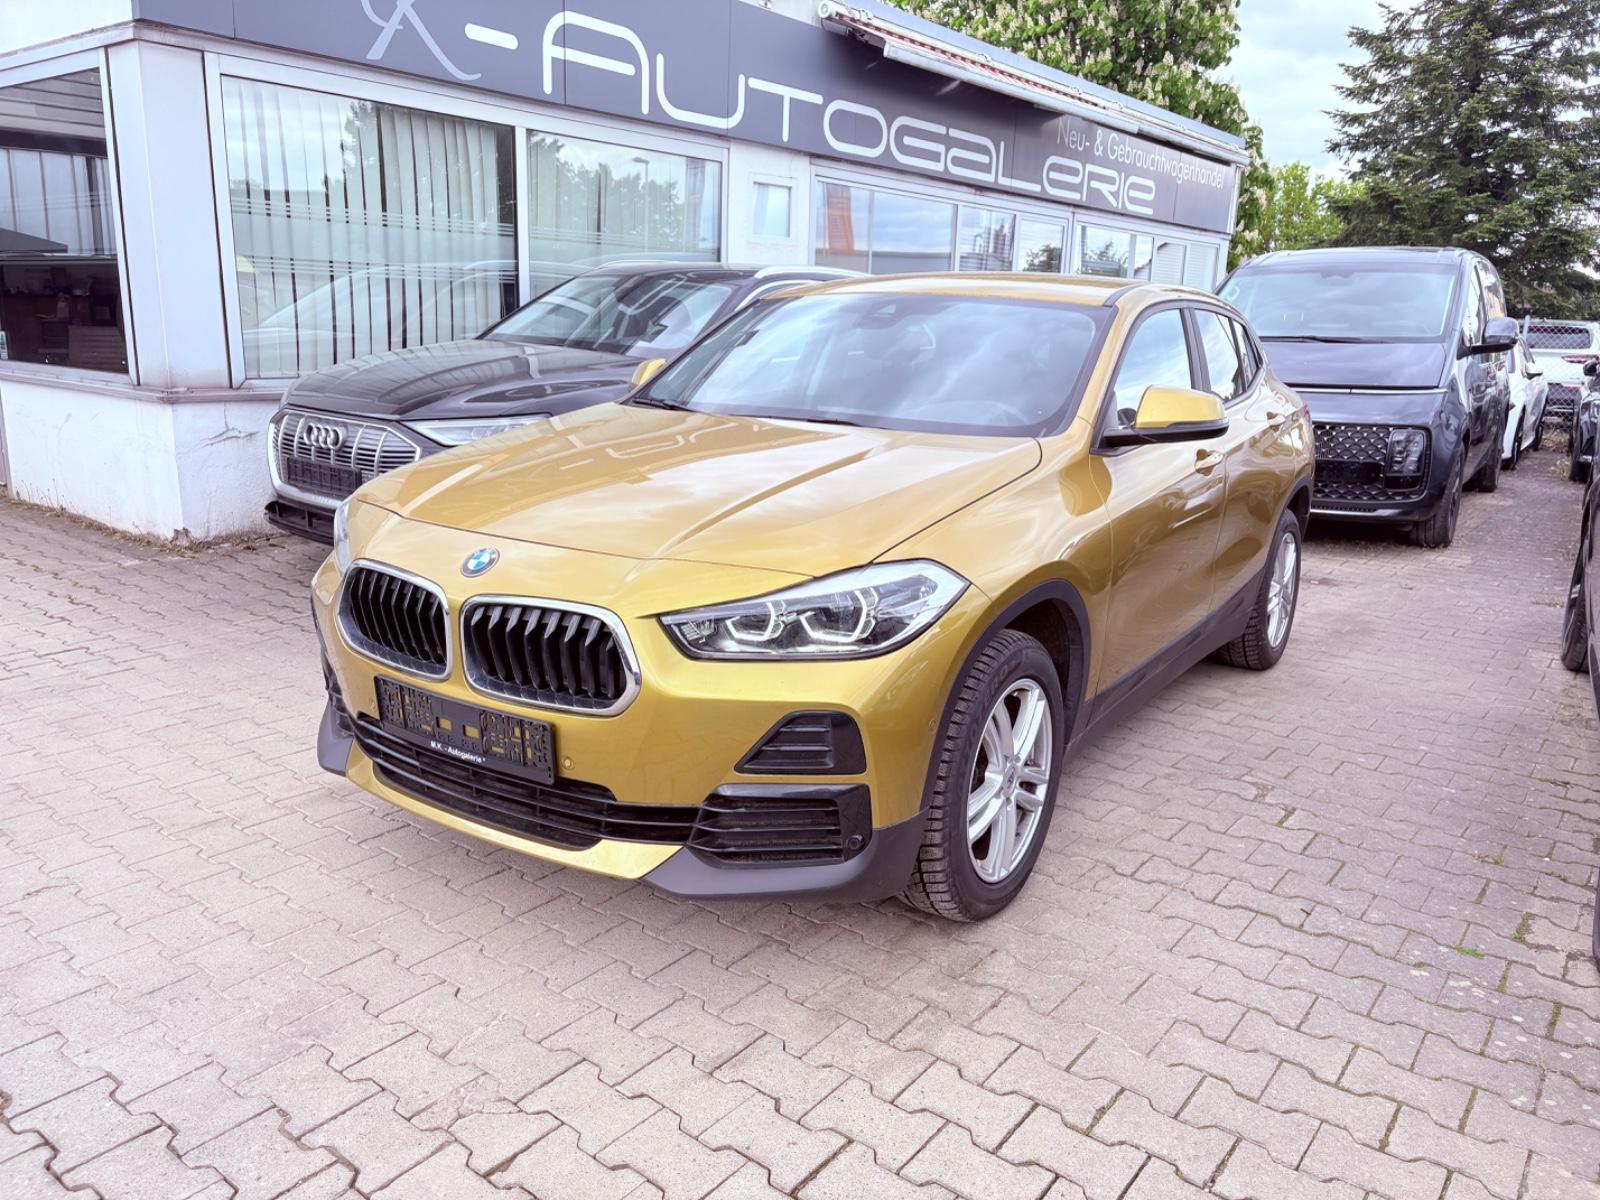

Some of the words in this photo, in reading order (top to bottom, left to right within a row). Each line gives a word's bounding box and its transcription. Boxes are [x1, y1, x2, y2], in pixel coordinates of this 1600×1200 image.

[1057, 119, 1090, 152] Neu-
[1094, 129, 1104, 157] &
[1107, 133, 1224, 189] Gebrauchtwagenhandel
[448, 746, 482, 763] Autogalerie
